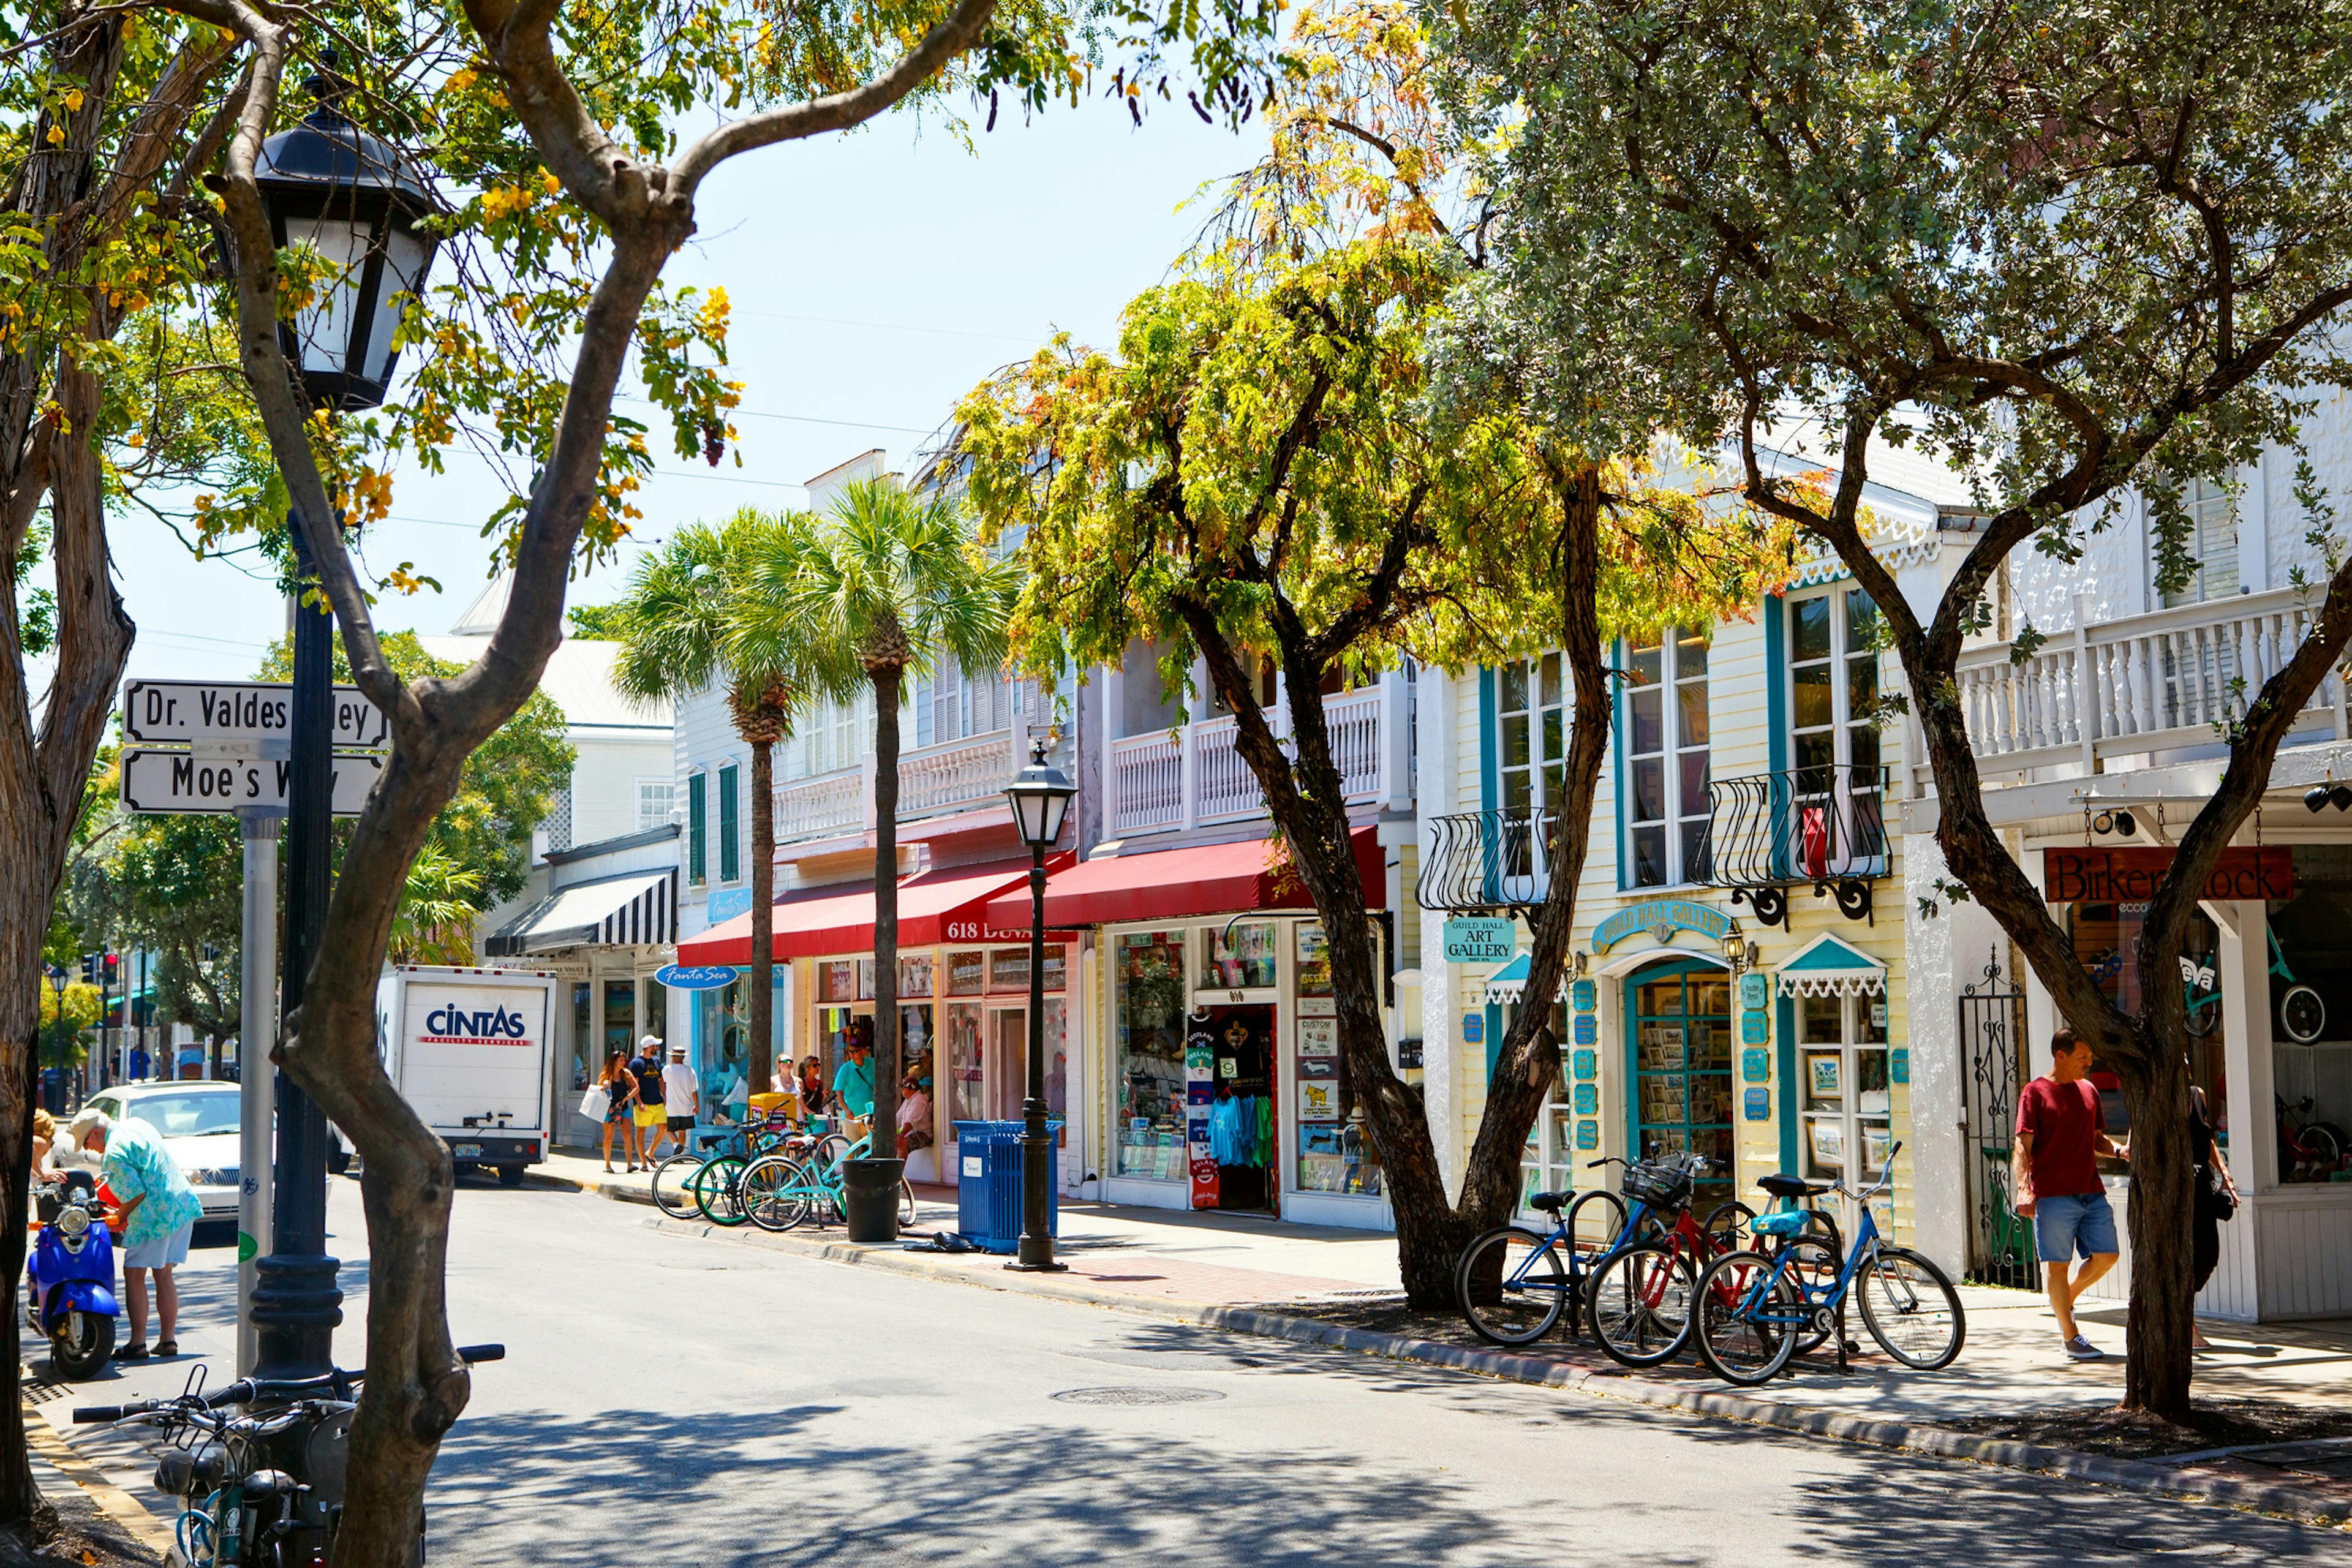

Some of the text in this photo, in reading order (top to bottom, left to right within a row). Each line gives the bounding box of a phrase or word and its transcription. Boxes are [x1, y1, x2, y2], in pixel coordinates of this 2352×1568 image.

[147, 689, 185, 726] Dr.
[200, 690, 287, 729] Valdes
[173, 757, 260, 797] Moe's
[2119, 903, 2147, 913] ecco
[1604, 904, 1724, 940] GUILD HALL GALLERY
[948, 922, 978, 938] 618
[1464, 930, 1494, 942] ART
[1449, 944, 1511, 956] GALLERY
[1188, 1032, 1214, 1042] SCOTLAND
[1187, 1051, 1213, 1061] IRELAND
[1193, 1159, 1218, 1170] POLAND
